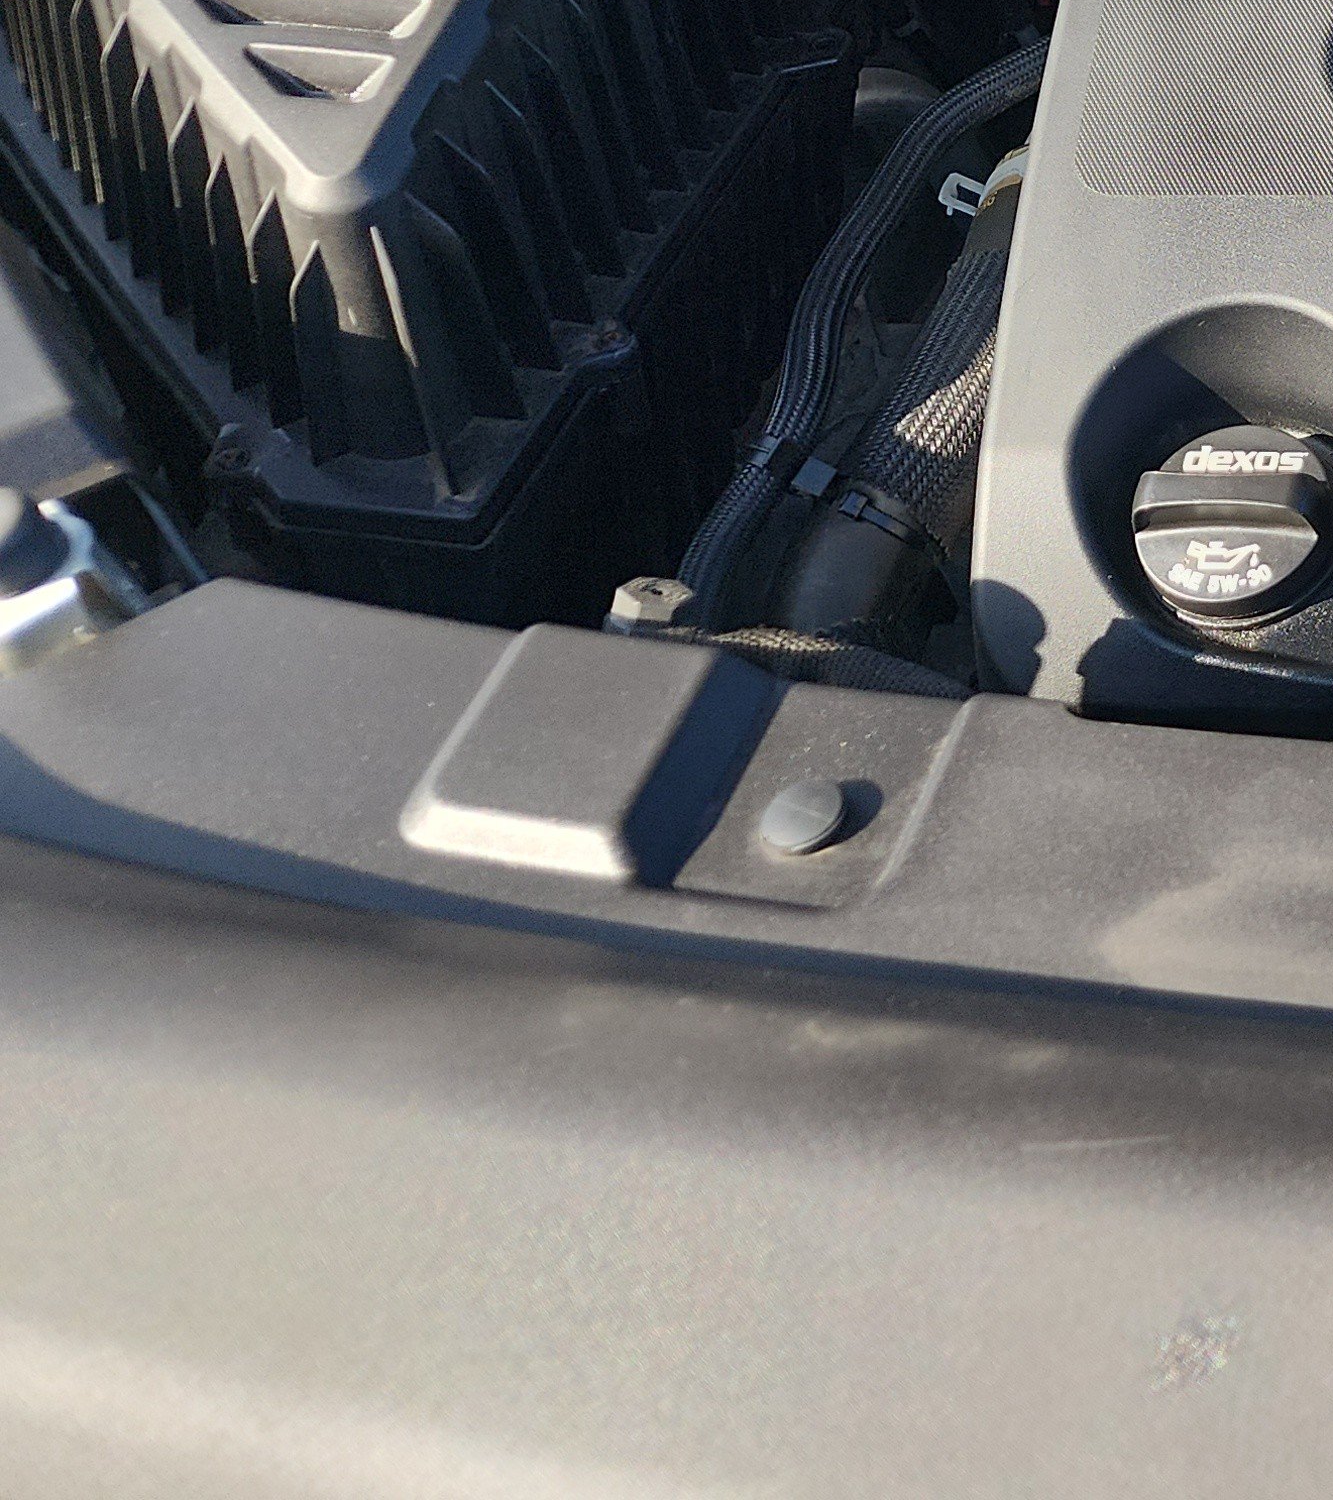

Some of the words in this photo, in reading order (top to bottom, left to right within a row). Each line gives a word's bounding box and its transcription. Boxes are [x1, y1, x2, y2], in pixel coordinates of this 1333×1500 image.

[1182, 445, 1309, 473] dexos
[1168, 563, 1205, 591] SAE
[1207, 564, 1273, 593] 5W-30
